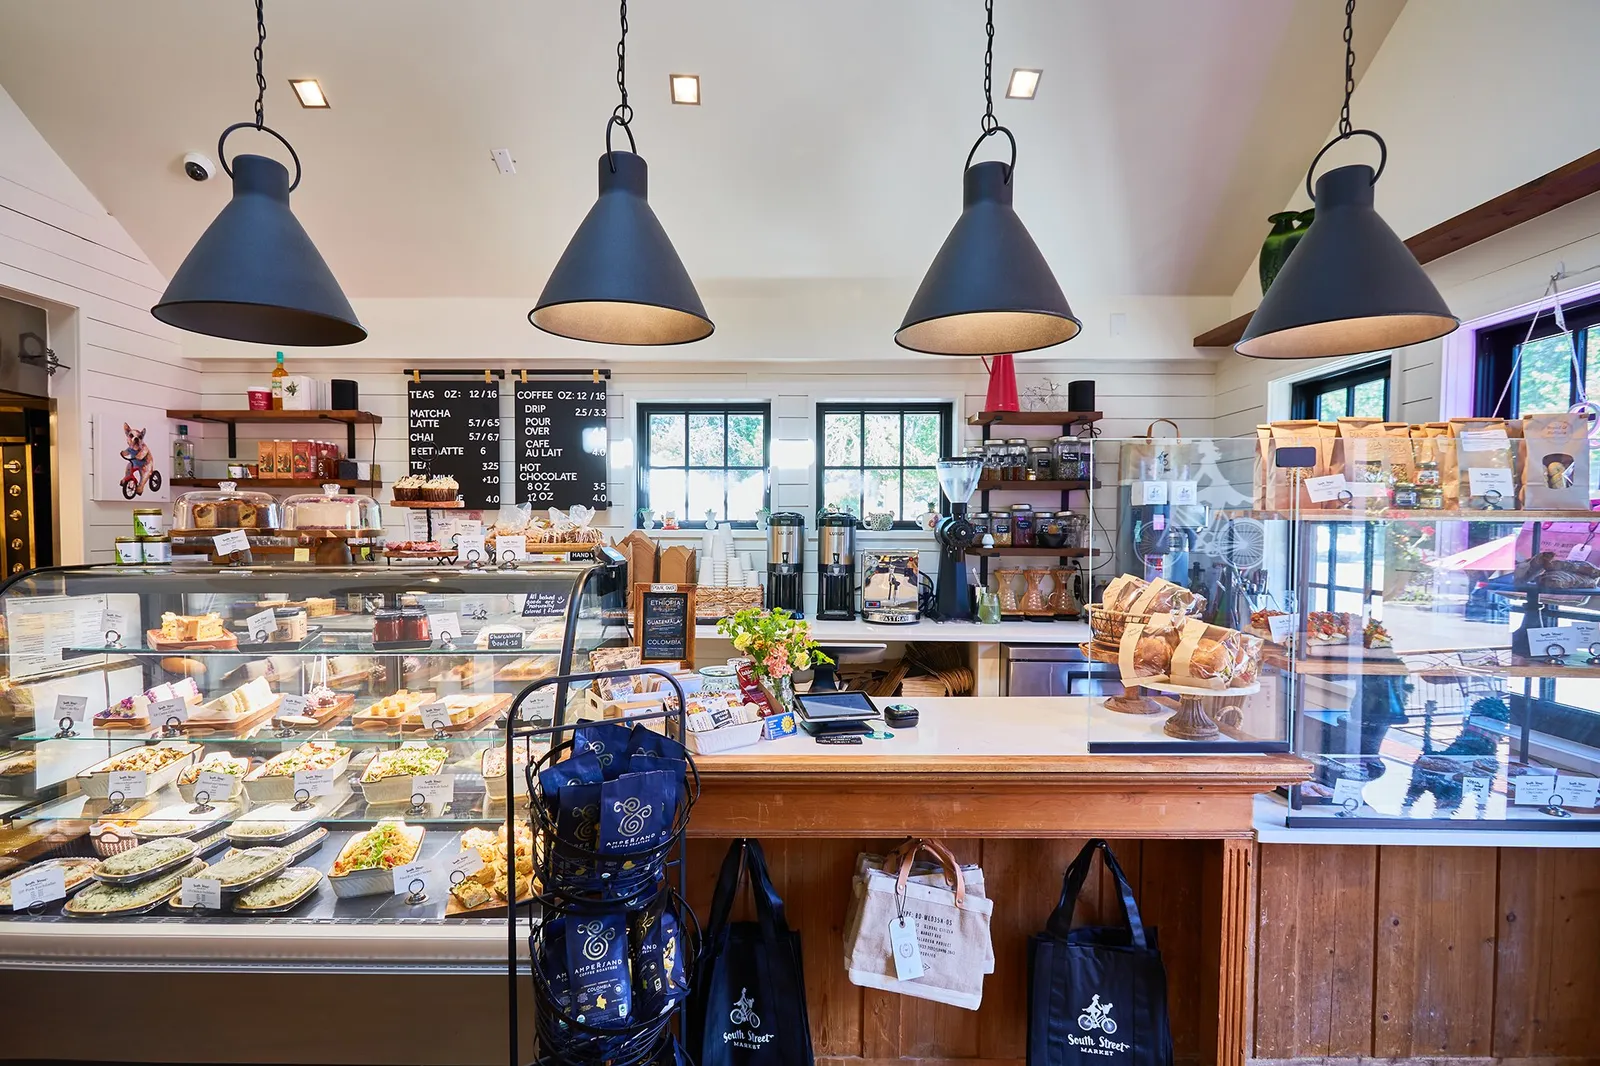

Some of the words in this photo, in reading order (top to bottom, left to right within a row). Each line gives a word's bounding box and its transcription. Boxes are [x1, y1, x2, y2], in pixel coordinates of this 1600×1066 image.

[409, 390, 435, 398] TEAS
[517, 390, 554, 400] COFFEE
[410, 409, 451, 418] MATCHA
[524, 404, 546, 414] DRIP
[410, 420, 440, 428] LATTE
[525, 418, 551, 426] POUR
[524, 427, 550, 436] OVER
[410, 433, 434, 442] CHAI
[525, 440, 550, 448] CAFE
[480, 446, 486, 455] 6
[525, 448, 539, 457] AU
[541, 448, 563, 456] LAIT
[520, 463, 541, 472] HOT
[520, 472, 578, 480] CHOCOLATE
[527, 482, 534, 491] 8
[593, 482, 606, 491] 3.5
[486, 495, 500, 503] 4.0
[527, 492, 537, 502] 12
[538, 492, 554, 500] OZ
[592, 494, 607, 502] 4.0
[606, 833, 656, 846] AMPERSAND
[574, 958, 622, 974] AMPERSAND
[587, 984, 612, 992] COLOMBIA
[722, 1030, 745, 1044] South
[748, 1030, 774, 1042] Street
[733, 1041, 760, 1050] MARKET
[1068, 1034, 1096, 1046] South
[1098, 1036, 1130, 1052] Street
[1080, 1046, 1114, 1056] MARKET
